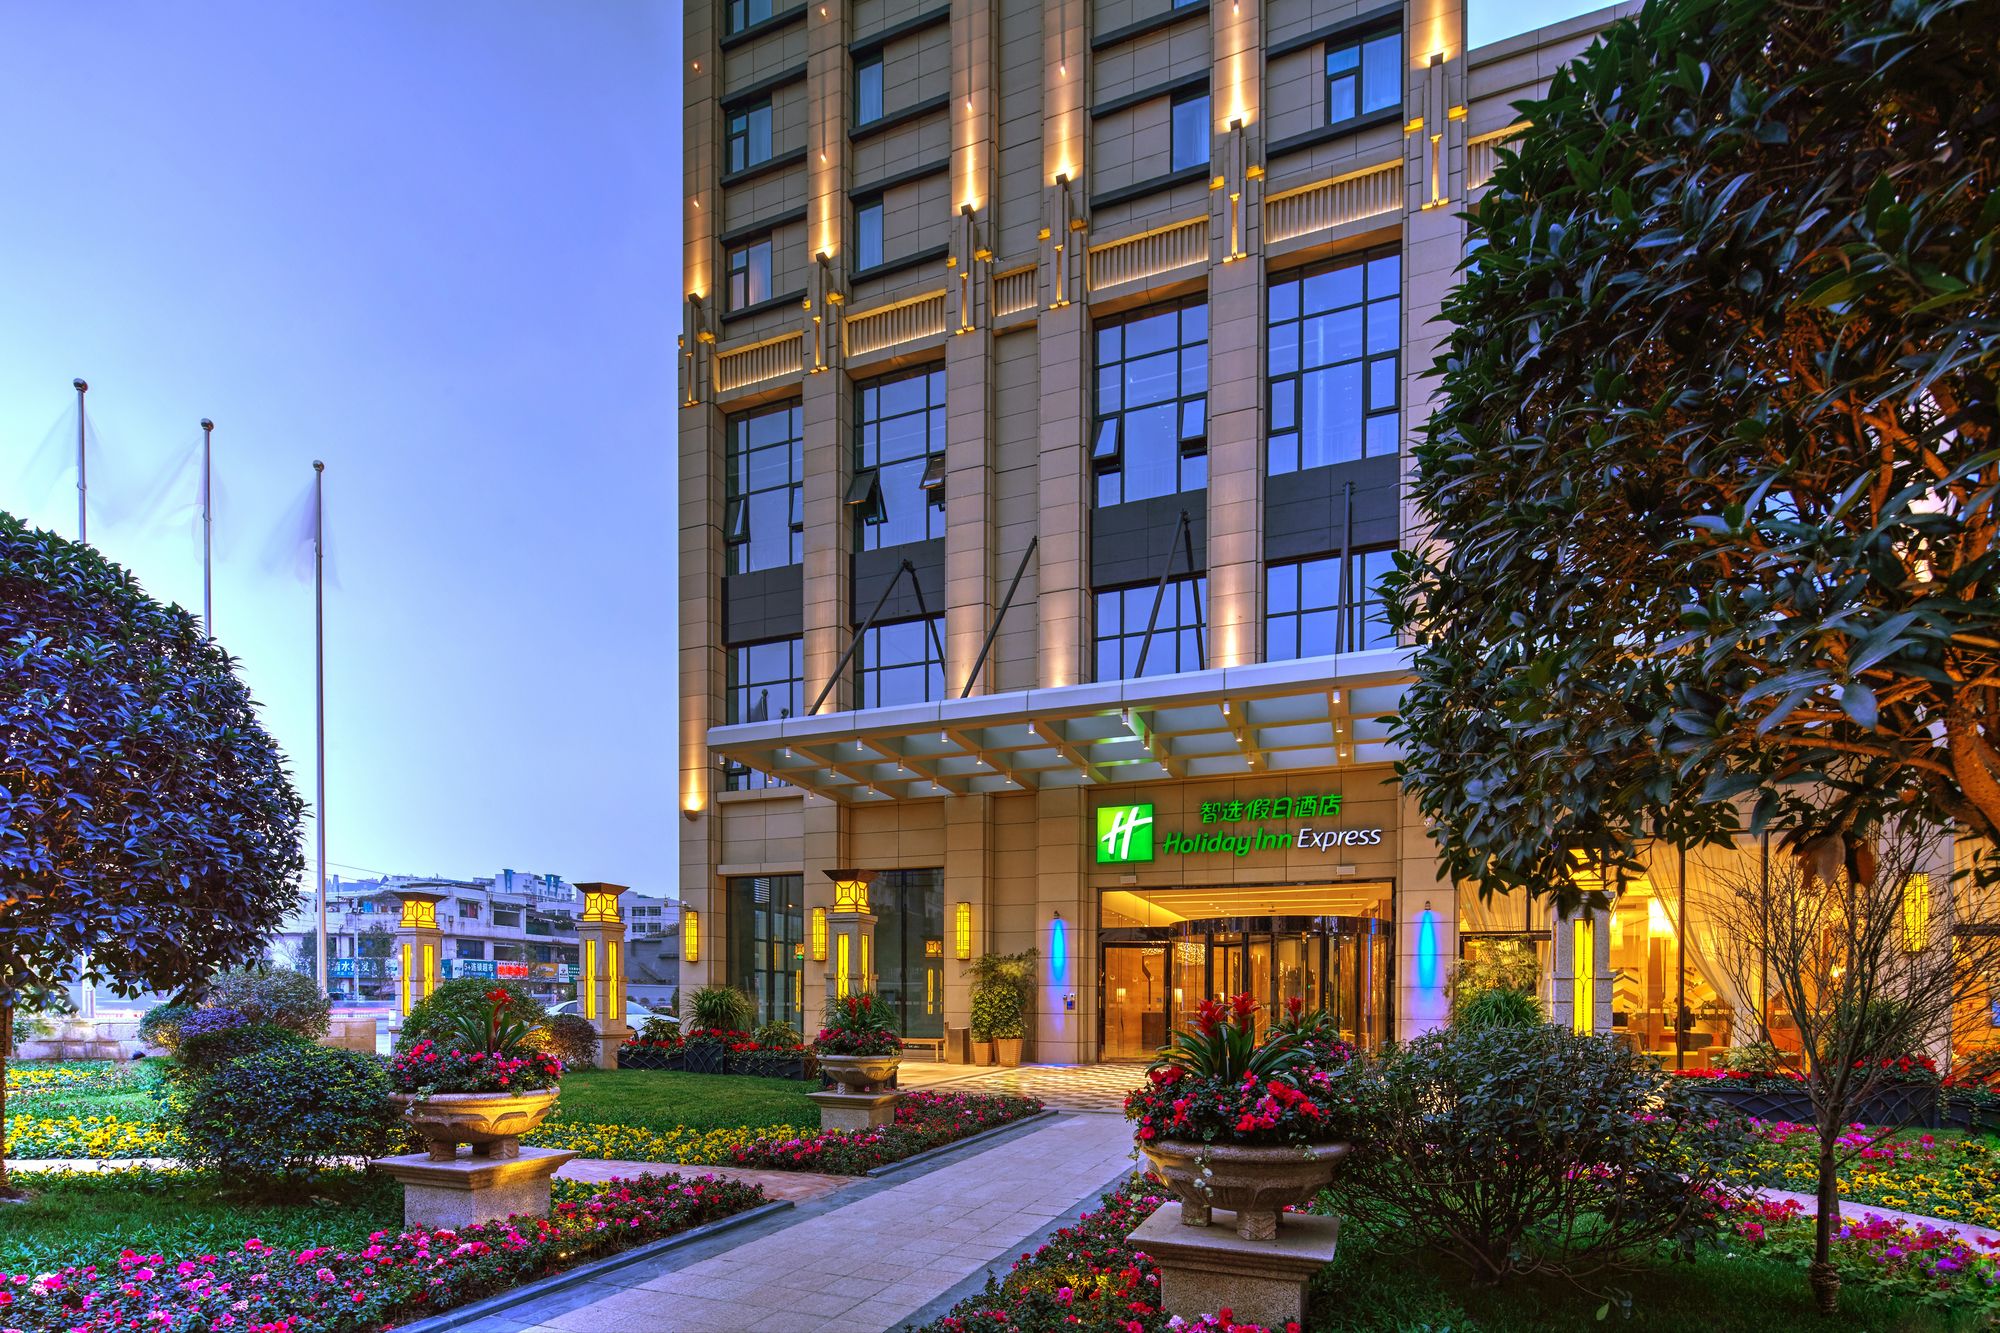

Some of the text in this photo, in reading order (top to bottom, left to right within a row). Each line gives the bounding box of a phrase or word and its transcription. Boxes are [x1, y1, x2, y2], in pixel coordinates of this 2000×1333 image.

[1200, 794, 1343, 824] 智选假日酒店
[1163, 828, 1382, 856] Holiday Inn Express
